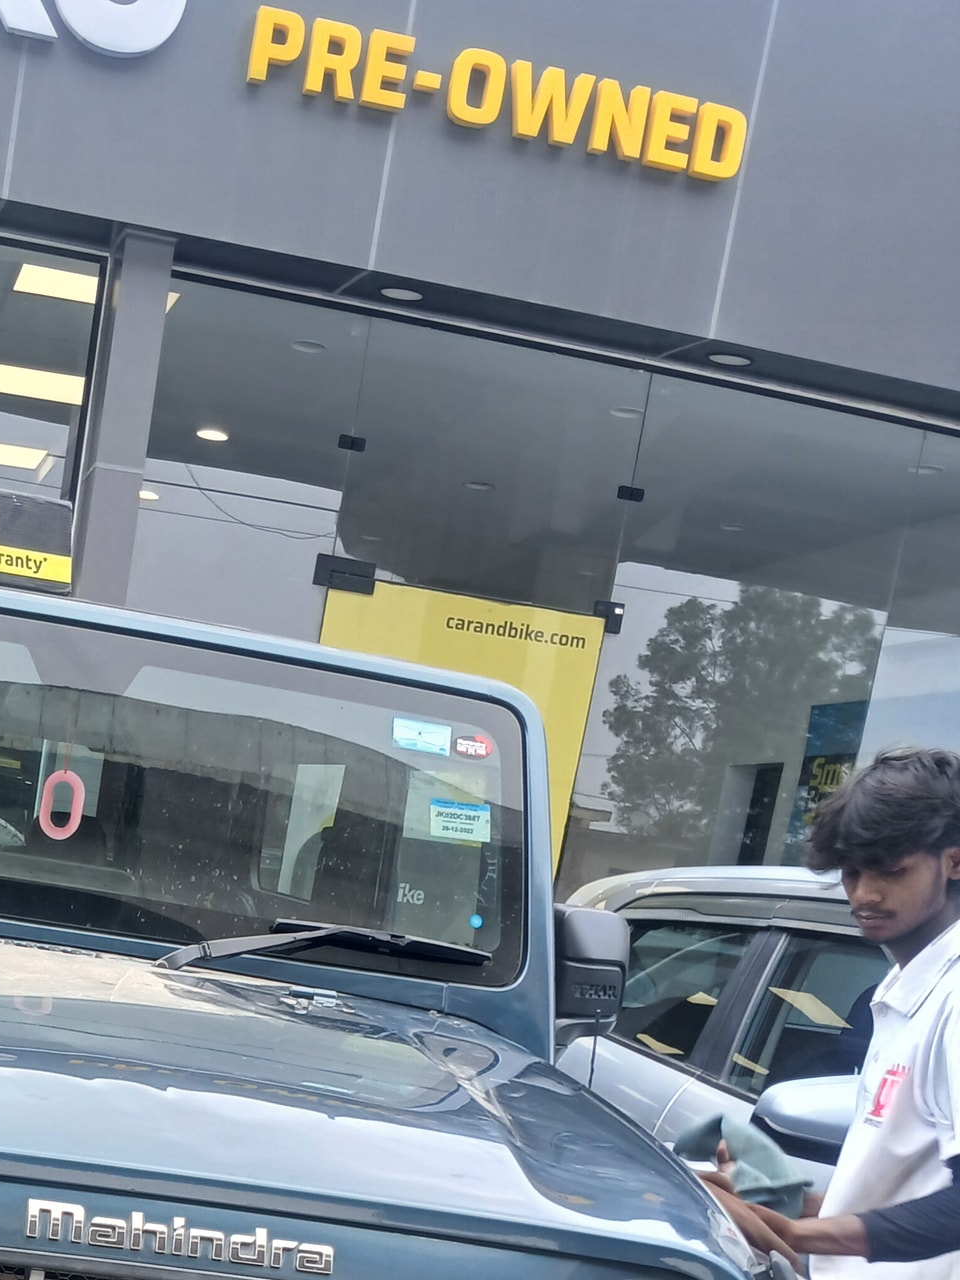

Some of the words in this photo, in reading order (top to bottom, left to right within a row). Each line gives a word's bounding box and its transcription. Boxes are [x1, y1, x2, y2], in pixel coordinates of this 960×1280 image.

[246, 5, 748, 182] PRE-OWNED
[446, 616, 586, 649] carandbike.com
[26, 1198, 335, 1275] Mahindra
